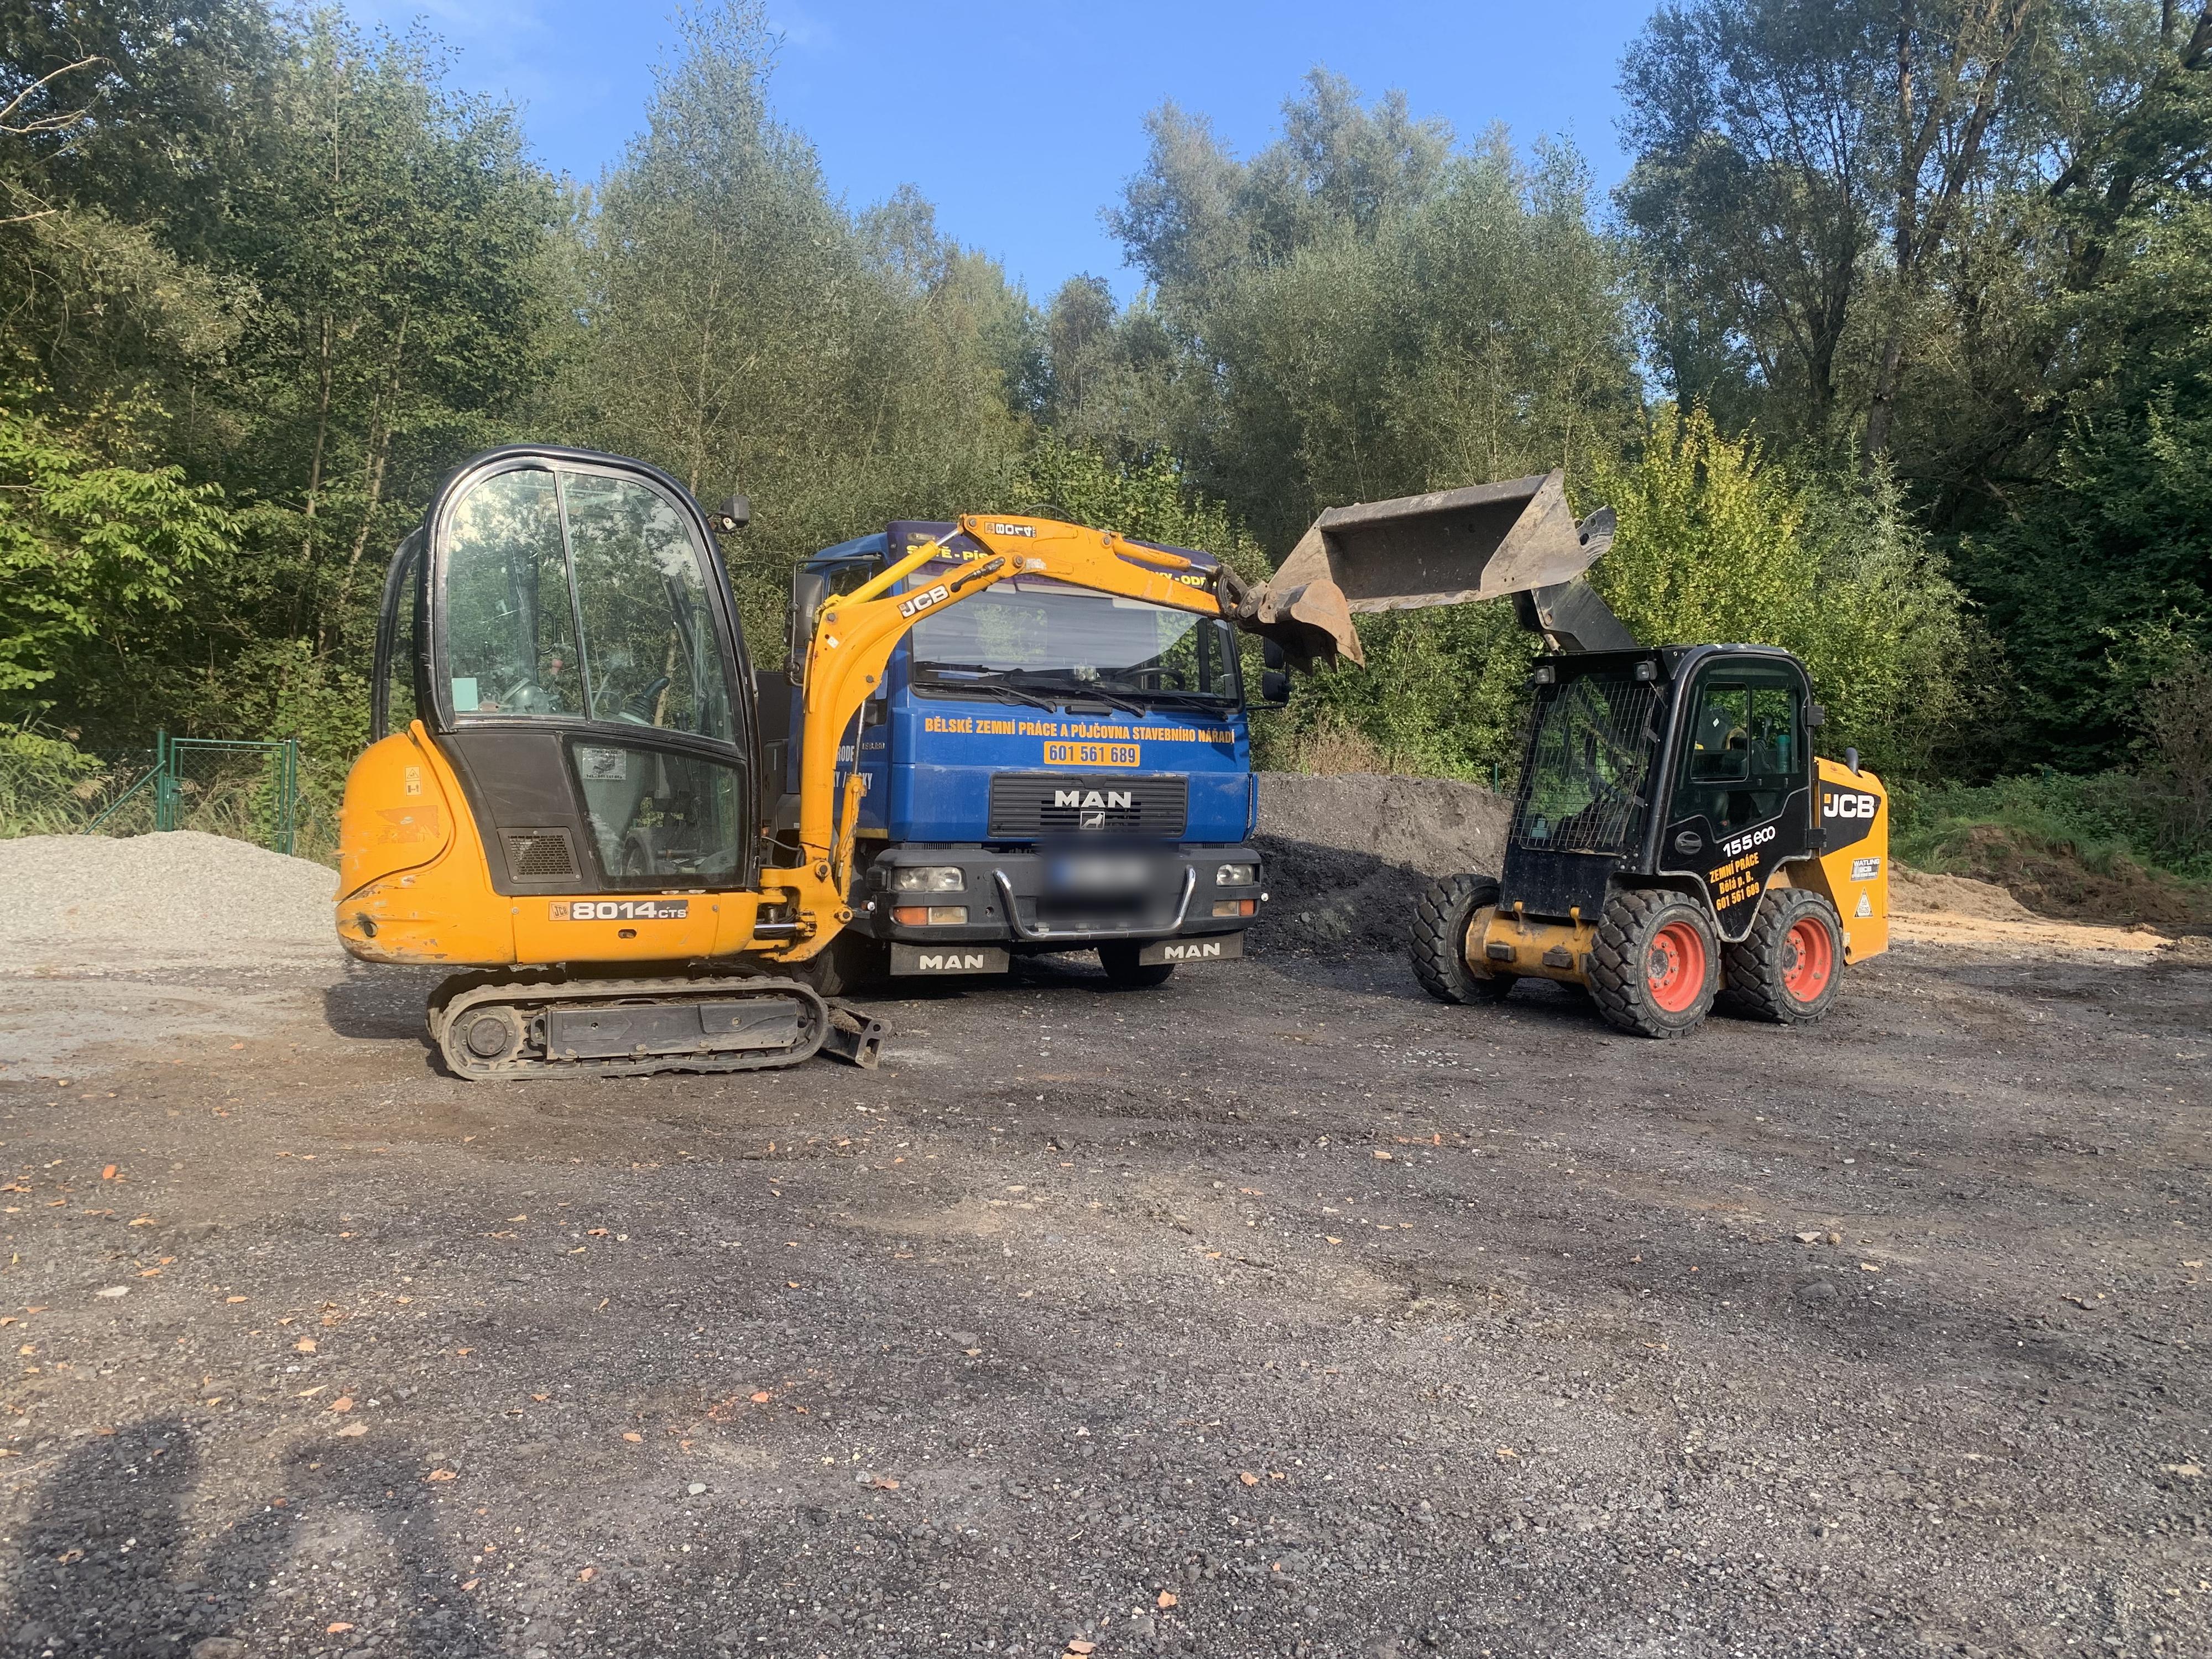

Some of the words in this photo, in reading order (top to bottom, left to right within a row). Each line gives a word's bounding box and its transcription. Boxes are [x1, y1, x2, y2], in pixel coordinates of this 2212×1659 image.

[899, 585, 949, 618] JCB
[925, 716, 973, 733] BĚLSKÉ
[975, 719, 1015, 735] ZEMNÍ
[1018, 720, 1057, 737] PRÁCE
[1060, 726, 1068, 737] A
[1071, 721, 1130, 739] PŮJČOVNA
[1133, 726, 1196, 742] STAVEBNÍHO
[1198, 728, 1235, 744] NÁŘADÍ
[1049, 744, 1074, 761] 601
[1080, 745, 1104, 762] 561
[1110, 747, 1136, 763] 689
[1054, 791, 1131, 808] MAN
[1824, 794, 1875, 818] JCB
[1723, 834, 1753, 857] 155
[1709, 860, 1735, 884] ZEMNÍ
[1735, 852, 1760, 873] PRÁCE
[1719, 877, 1737, 895] Bělá
[1738, 875, 1745, 888] p.
[1745, 870, 1754, 883] B.
[1716, 895, 1730, 911] 601
[1731, 888, 1745, 904] 561
[1746, 881, 1760, 898] 689
[554, 905, 568, 917] JCB
[572, 901, 658, 920] 8014
[658, 909, 687, 919] CTS
[919, 954, 984, 970] MAN
[1164, 943, 1220, 960] MAN
